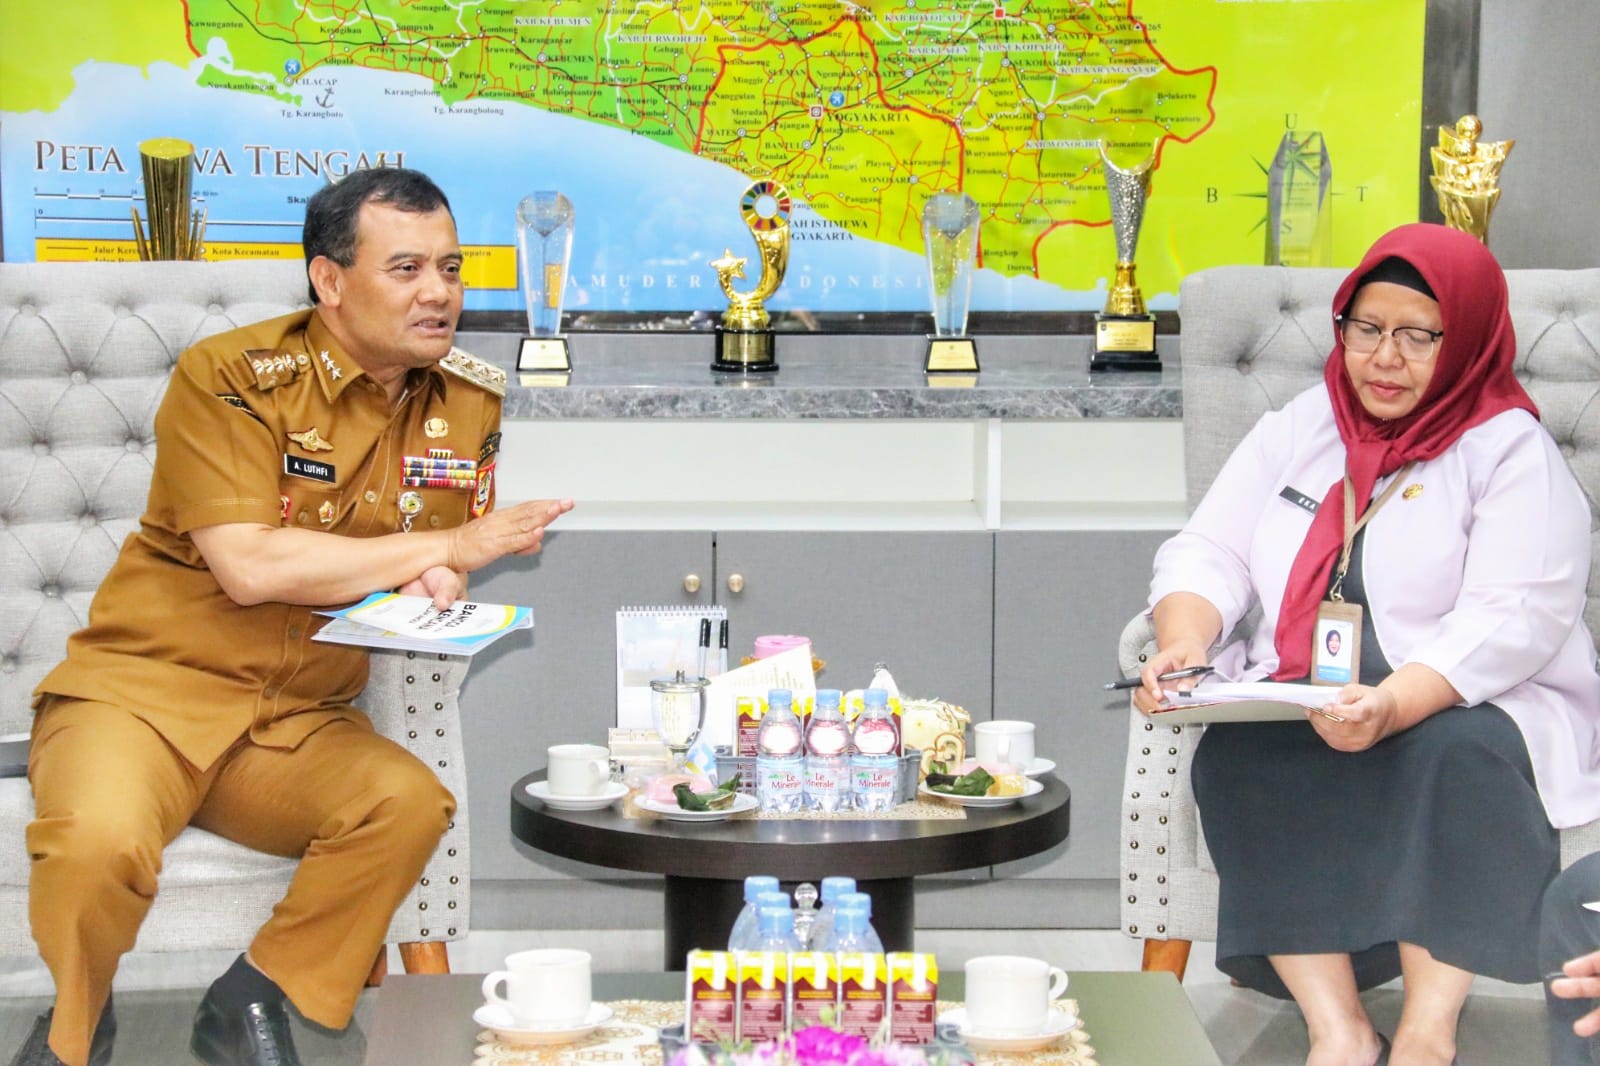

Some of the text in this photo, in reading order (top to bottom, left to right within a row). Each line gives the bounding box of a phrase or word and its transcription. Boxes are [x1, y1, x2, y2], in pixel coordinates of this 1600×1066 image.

[827, 113, 910, 122] YOGYAKARTA
[1286, 114, 1297, 129] U
[35, 140, 125, 173] PETA
[244, 145, 403, 176] TENGAH
[1207, 188, 1218, 203] B
[1356, 186, 1368, 202] T
[810, 220, 868, 228] ISTIMEWA
[792, 232, 853, 241] GYAKARTA
[294, 462, 328, 476] A. LUTHFI
